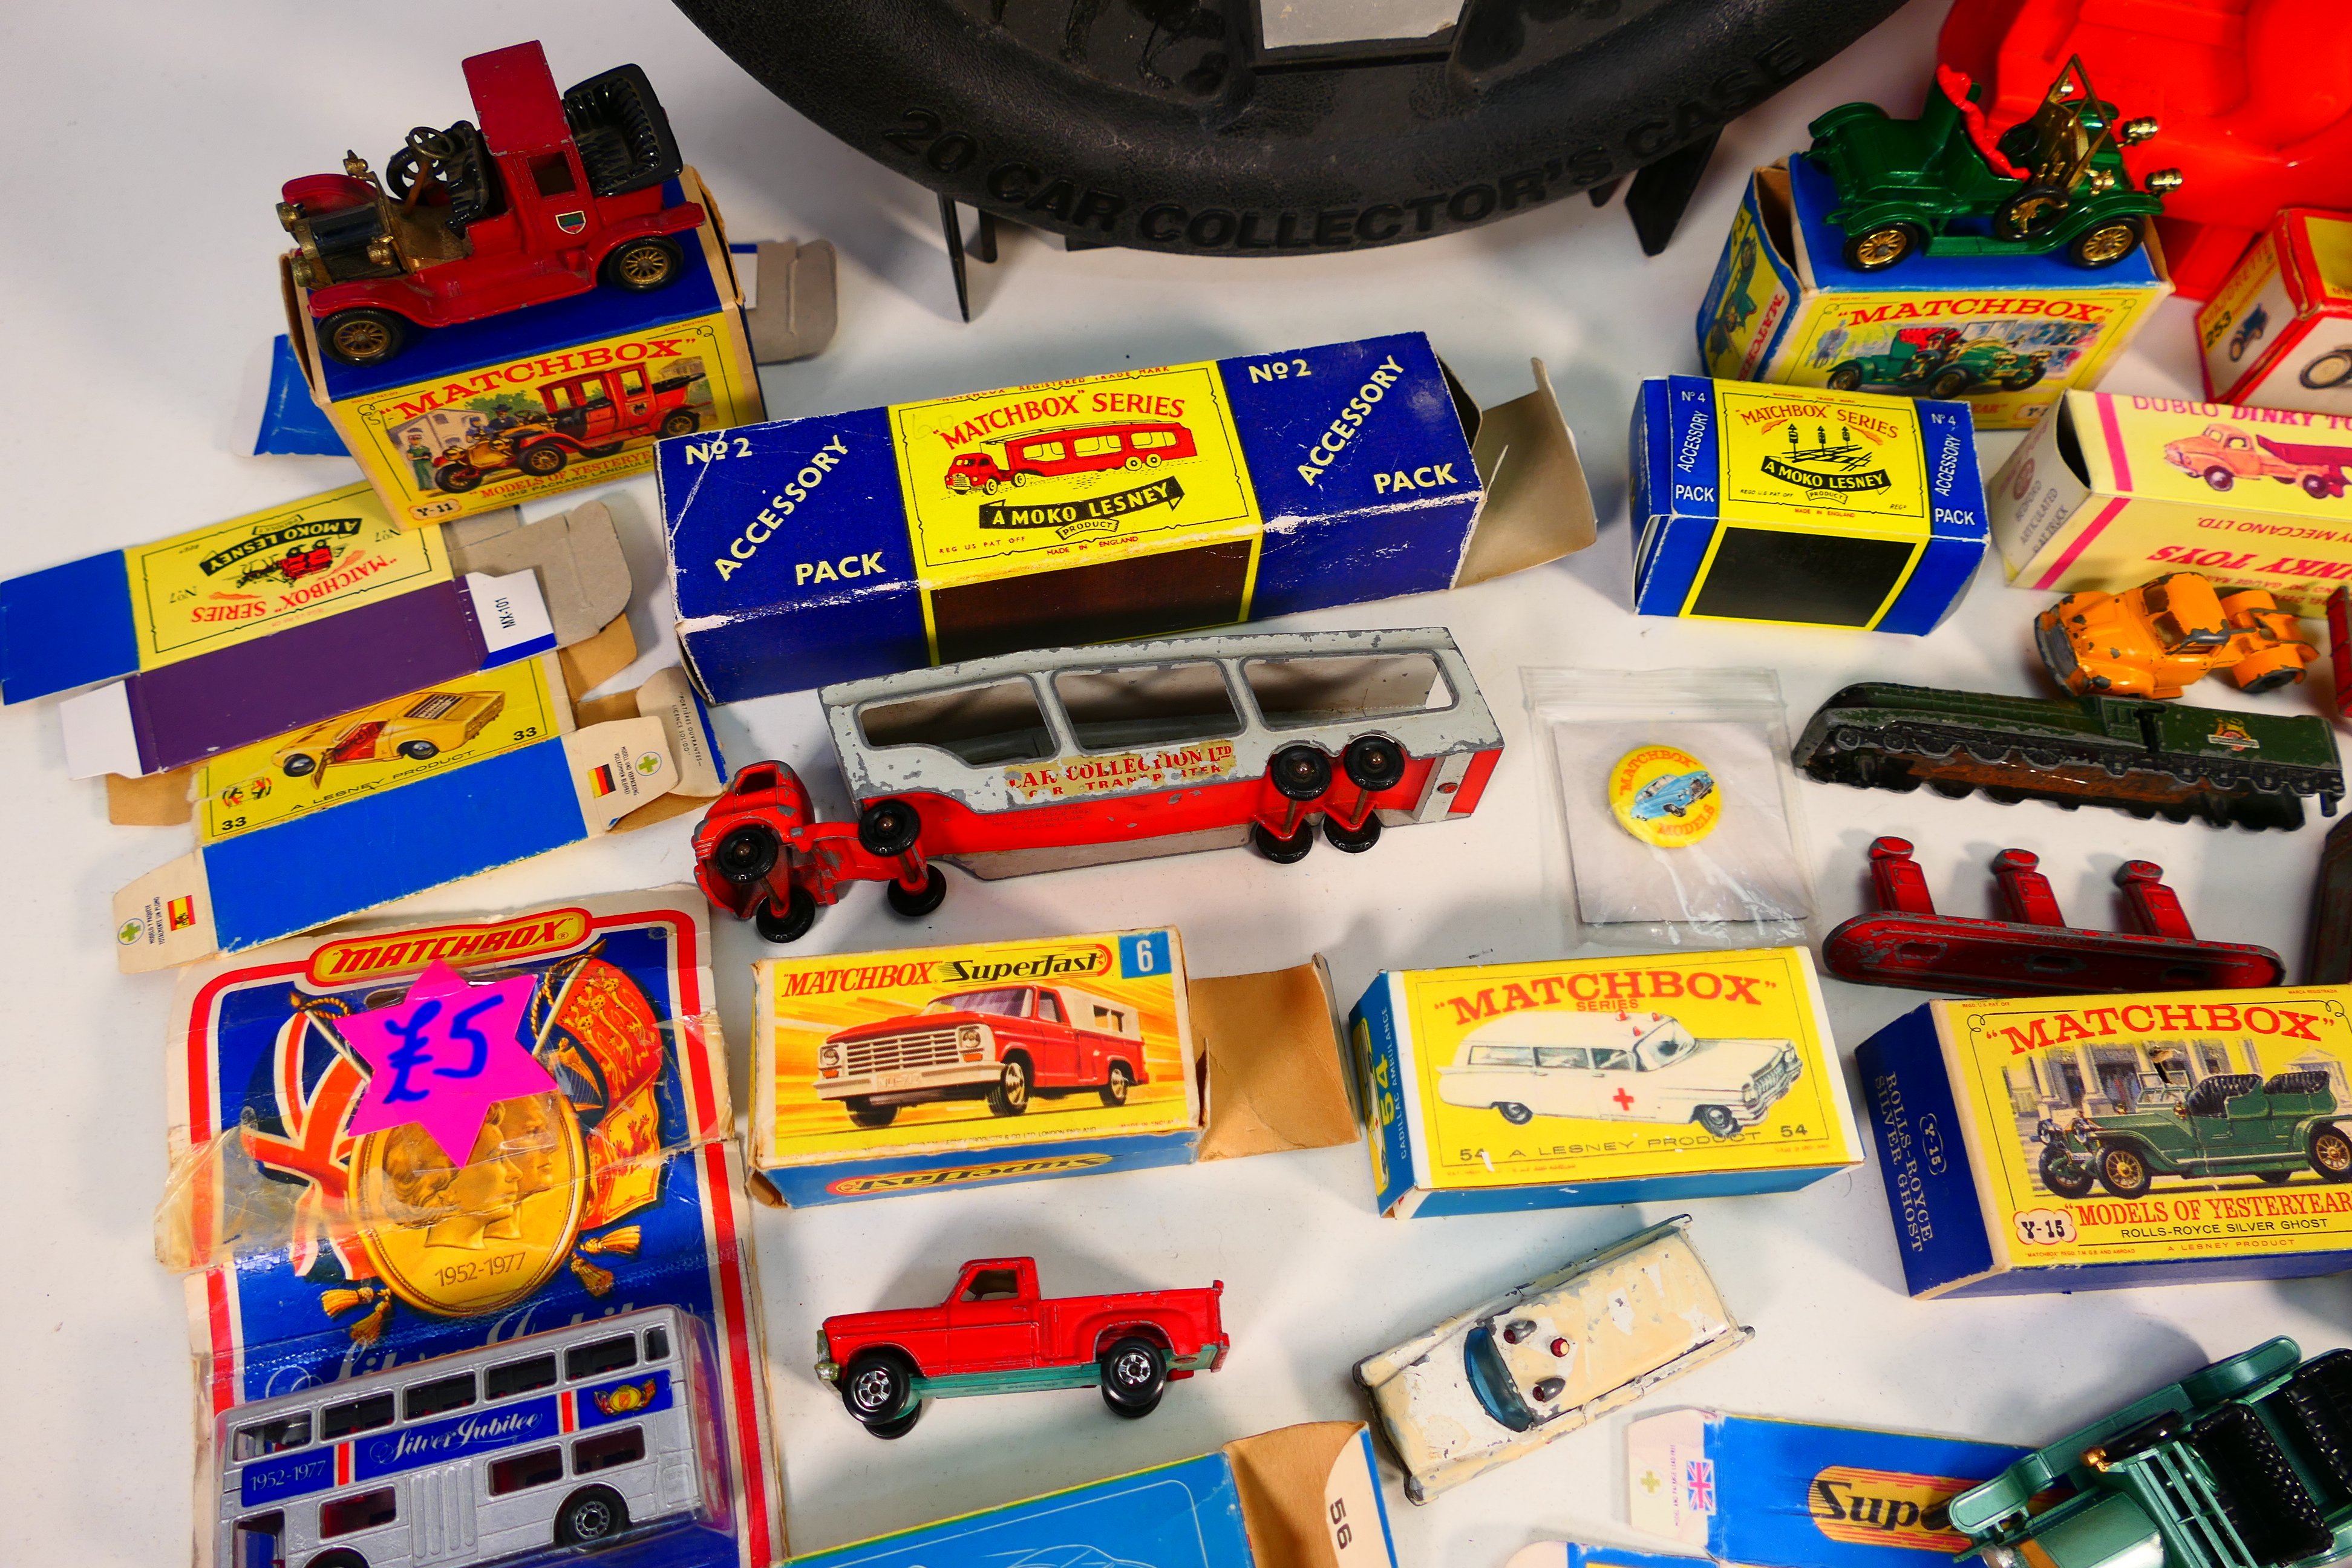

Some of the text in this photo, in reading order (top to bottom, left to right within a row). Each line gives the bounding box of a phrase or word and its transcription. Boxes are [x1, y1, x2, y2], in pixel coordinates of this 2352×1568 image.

[880, 37, 1809, 249] 20 CAR COLLECTOR'S CASE
[1093, 393, 1185, 418] SERIES
[1297, 355, 1404, 486] ACCESSORY
[2133, 395, 2221, 417] DUBLO
[1837, 409, 1899, 439] SERIES
[1677, 410, 1709, 472] ACCESSORY
[547, 470, 567, 483] OF
[1373, 463, 1458, 494] PACK
[1765, 462, 1883, 489] A MOKO LESNEY
[1934, 434, 1962, 496] ACCESSORY
[532, 474, 587, 492] PACKARD
[1676, 485, 1714, 503] PACK
[1810, 491, 1843, 500] PRODUCT
[416, 503, 454, 517] Y-11
[714, 434, 849, 581] ACCESSORY
[993, 483, 1174, 526] A MOKO LESNEY
[1935, 508, 1975, 525] PACK
[1062, 520, 1113, 536] PRODUCT
[2237, 522, 2338, 540] MECCANO
[210, 520, 358, 570] A MOKO LESNEY
[1047, 547, 1071, 556] MADE
[1099, 535, 1139, 547] ENGLAND
[2146, 546, 2258, 569] TOYS
[795, 552, 886, 585] PACK
[191, 601, 267, 623] SERIES
[672, 704, 683, 728] LICENCE
[514, 727, 537, 741] 33
[313, 778, 385, 804] LESNEY
[392, 750, 477, 780] PRODUCT
[221, 816, 247, 831] 33
[1657, 804, 1715, 836] MODELS
[944, 952, 1100, 983] Superfast
[1137, 940, 1153, 972] 6
[1576, 998, 1639, 1011] SERIES
[383, 995, 504, 1104] £5
[1376, 1053, 1394, 1126] 54
[1382, 1006, 1406, 1160] CADILLAC AMBULANCE
[1460, 1148, 1486, 1161] 54
[1509, 1148, 1526, 1157] A
[1539, 1141, 1635, 1156] LESNEY
[1647, 1132, 1761, 1149] PRODUCT
[1780, 1125, 1809, 1138] 54
[1886, 1071, 1934, 1242] ROLLS-ROYCE
[1924, 1123, 1941, 1166] Y-15
[856, 1154, 1108, 1192] Superfast
[1875, 1076, 1924, 1252] SILVER GHOST
[2174, 1200, 2203, 1221] OF
[2020, 1220, 2066, 1240] Y-15
[2121, 1218, 2328, 1239] ROLLS-ROYCE SILVER GHOST
[2180, 1241, 2230, 1252] LESNEY
[2235, 1238, 2295, 1249] PRODUCT
[434, 1252, 526, 1287] 1952-1977
[370, 1410, 543, 1469] Silver Jubilee
[249, 1460, 327, 1492] 1952-1977
[1330, 1497, 1352, 1550] 56
